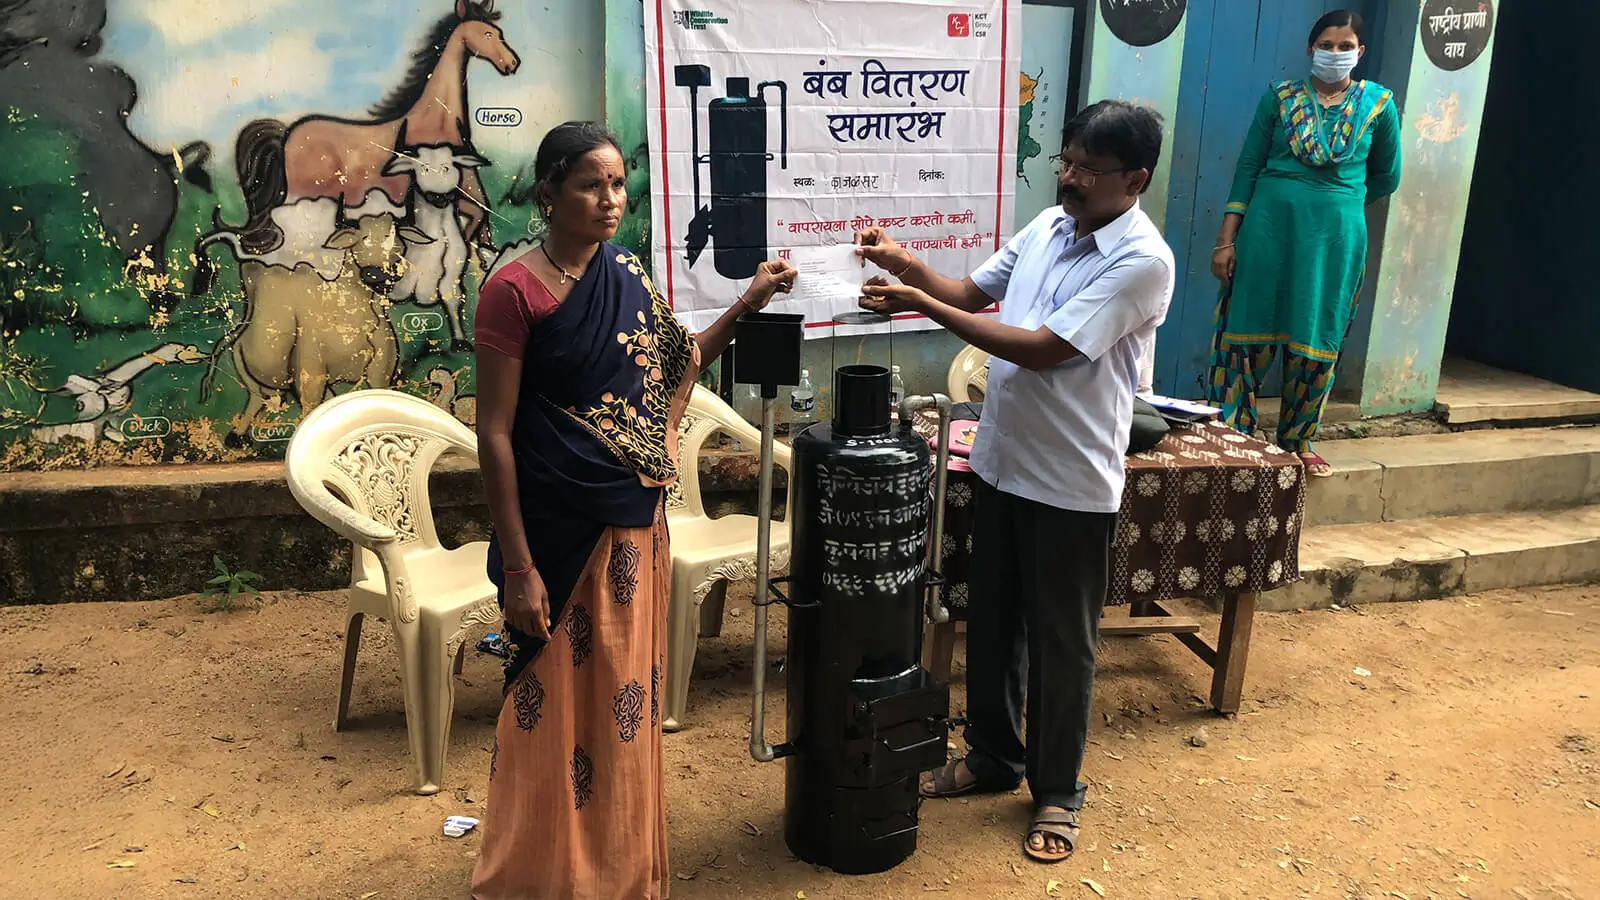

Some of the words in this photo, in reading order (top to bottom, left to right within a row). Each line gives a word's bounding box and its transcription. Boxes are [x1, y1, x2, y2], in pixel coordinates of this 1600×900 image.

[974, 21, 992, 29] Group
[1429, 6, 1462, 36] राष्ट्रीय
[1444, 42, 1467, 58] वाघ
[803, 59, 851, 99] बंब
[860, 59, 970, 101] वितरण
[482, 111, 516, 123] Horse
[826, 101, 946, 143] समारंभ
[788, 219, 847, 234] वापरायला
[878, 216, 907, 228] कष्ट
[910, 210, 944, 228] करतो
[911, 234, 957, 251] पाण्याची
